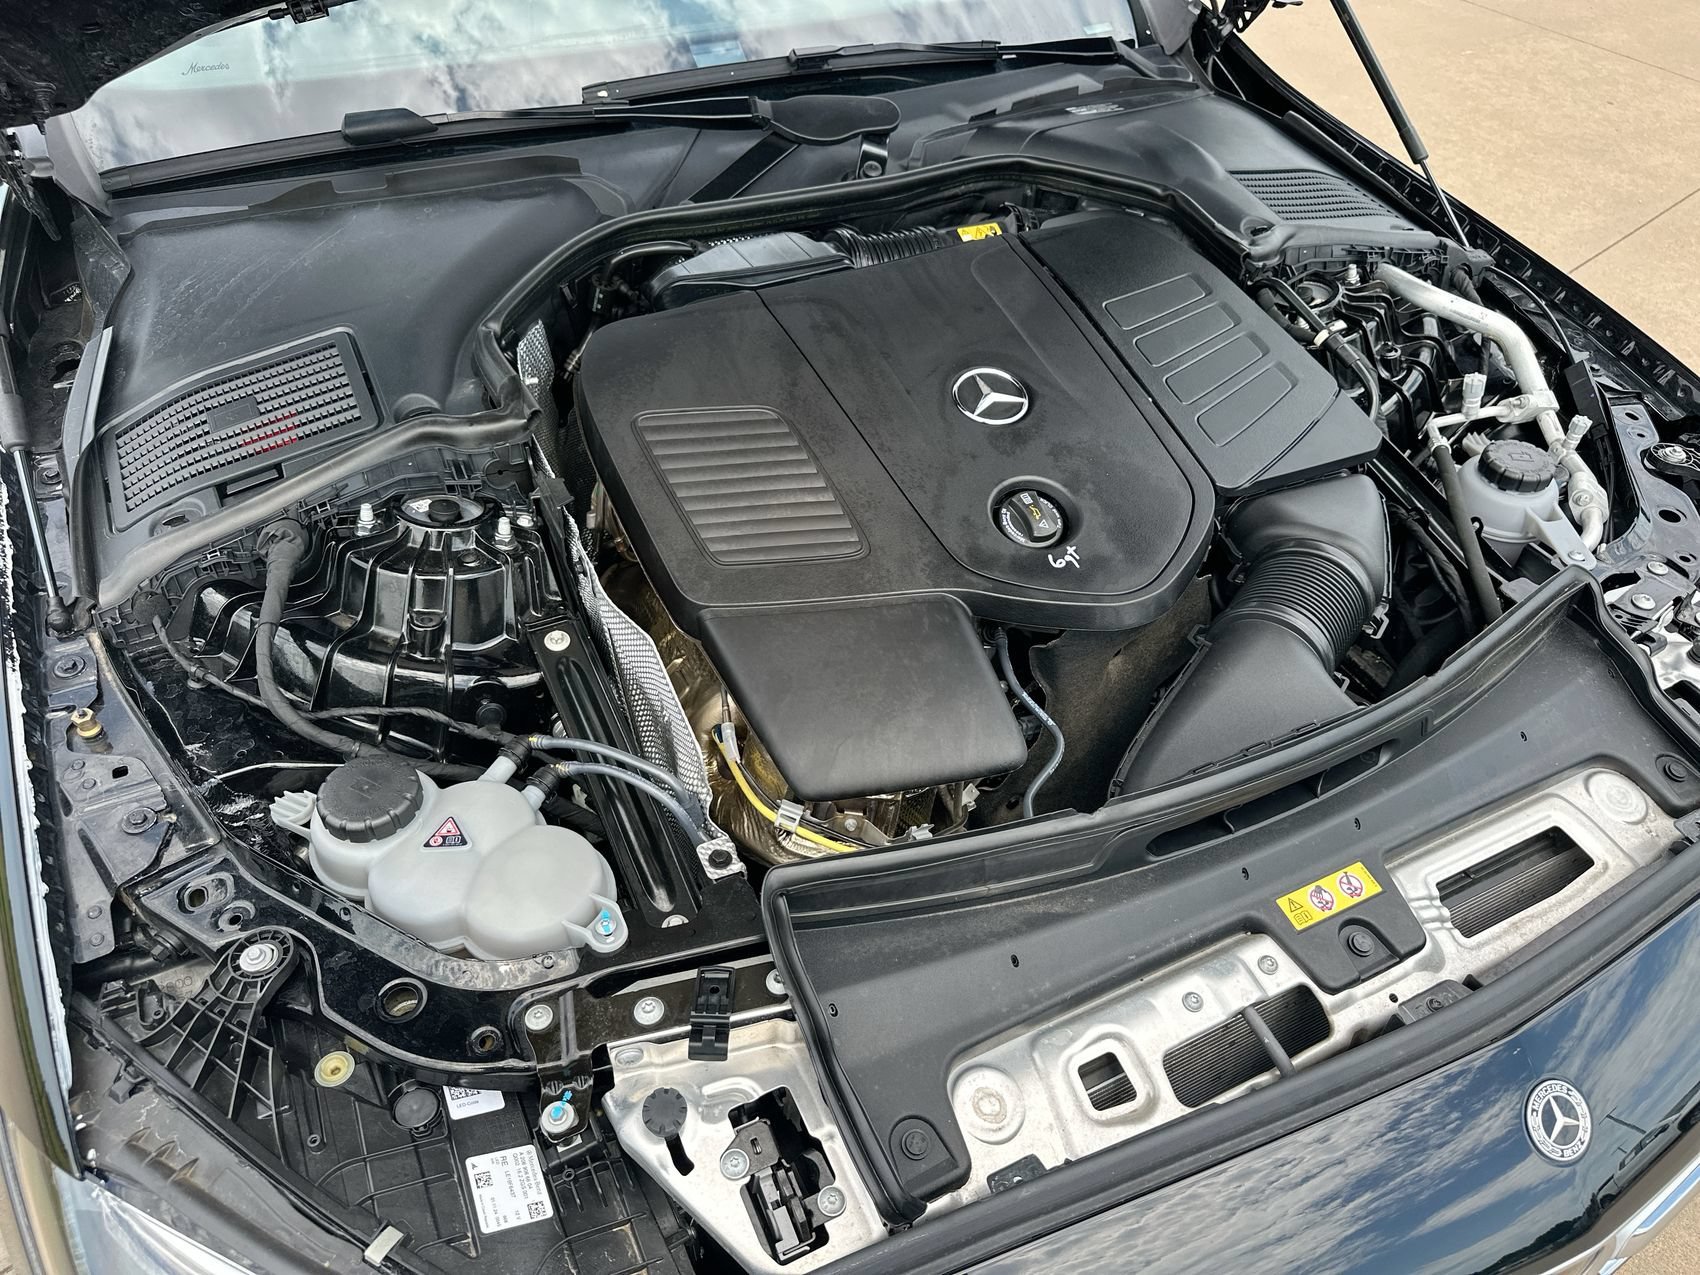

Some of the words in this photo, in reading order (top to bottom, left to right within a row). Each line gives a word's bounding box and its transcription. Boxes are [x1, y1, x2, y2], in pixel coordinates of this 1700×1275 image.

[1532, 1084, 1568, 1111] MERCEDES
[1563, 1139, 1584, 1157] BENZ
[499, 1155, 509, 1167] RE
